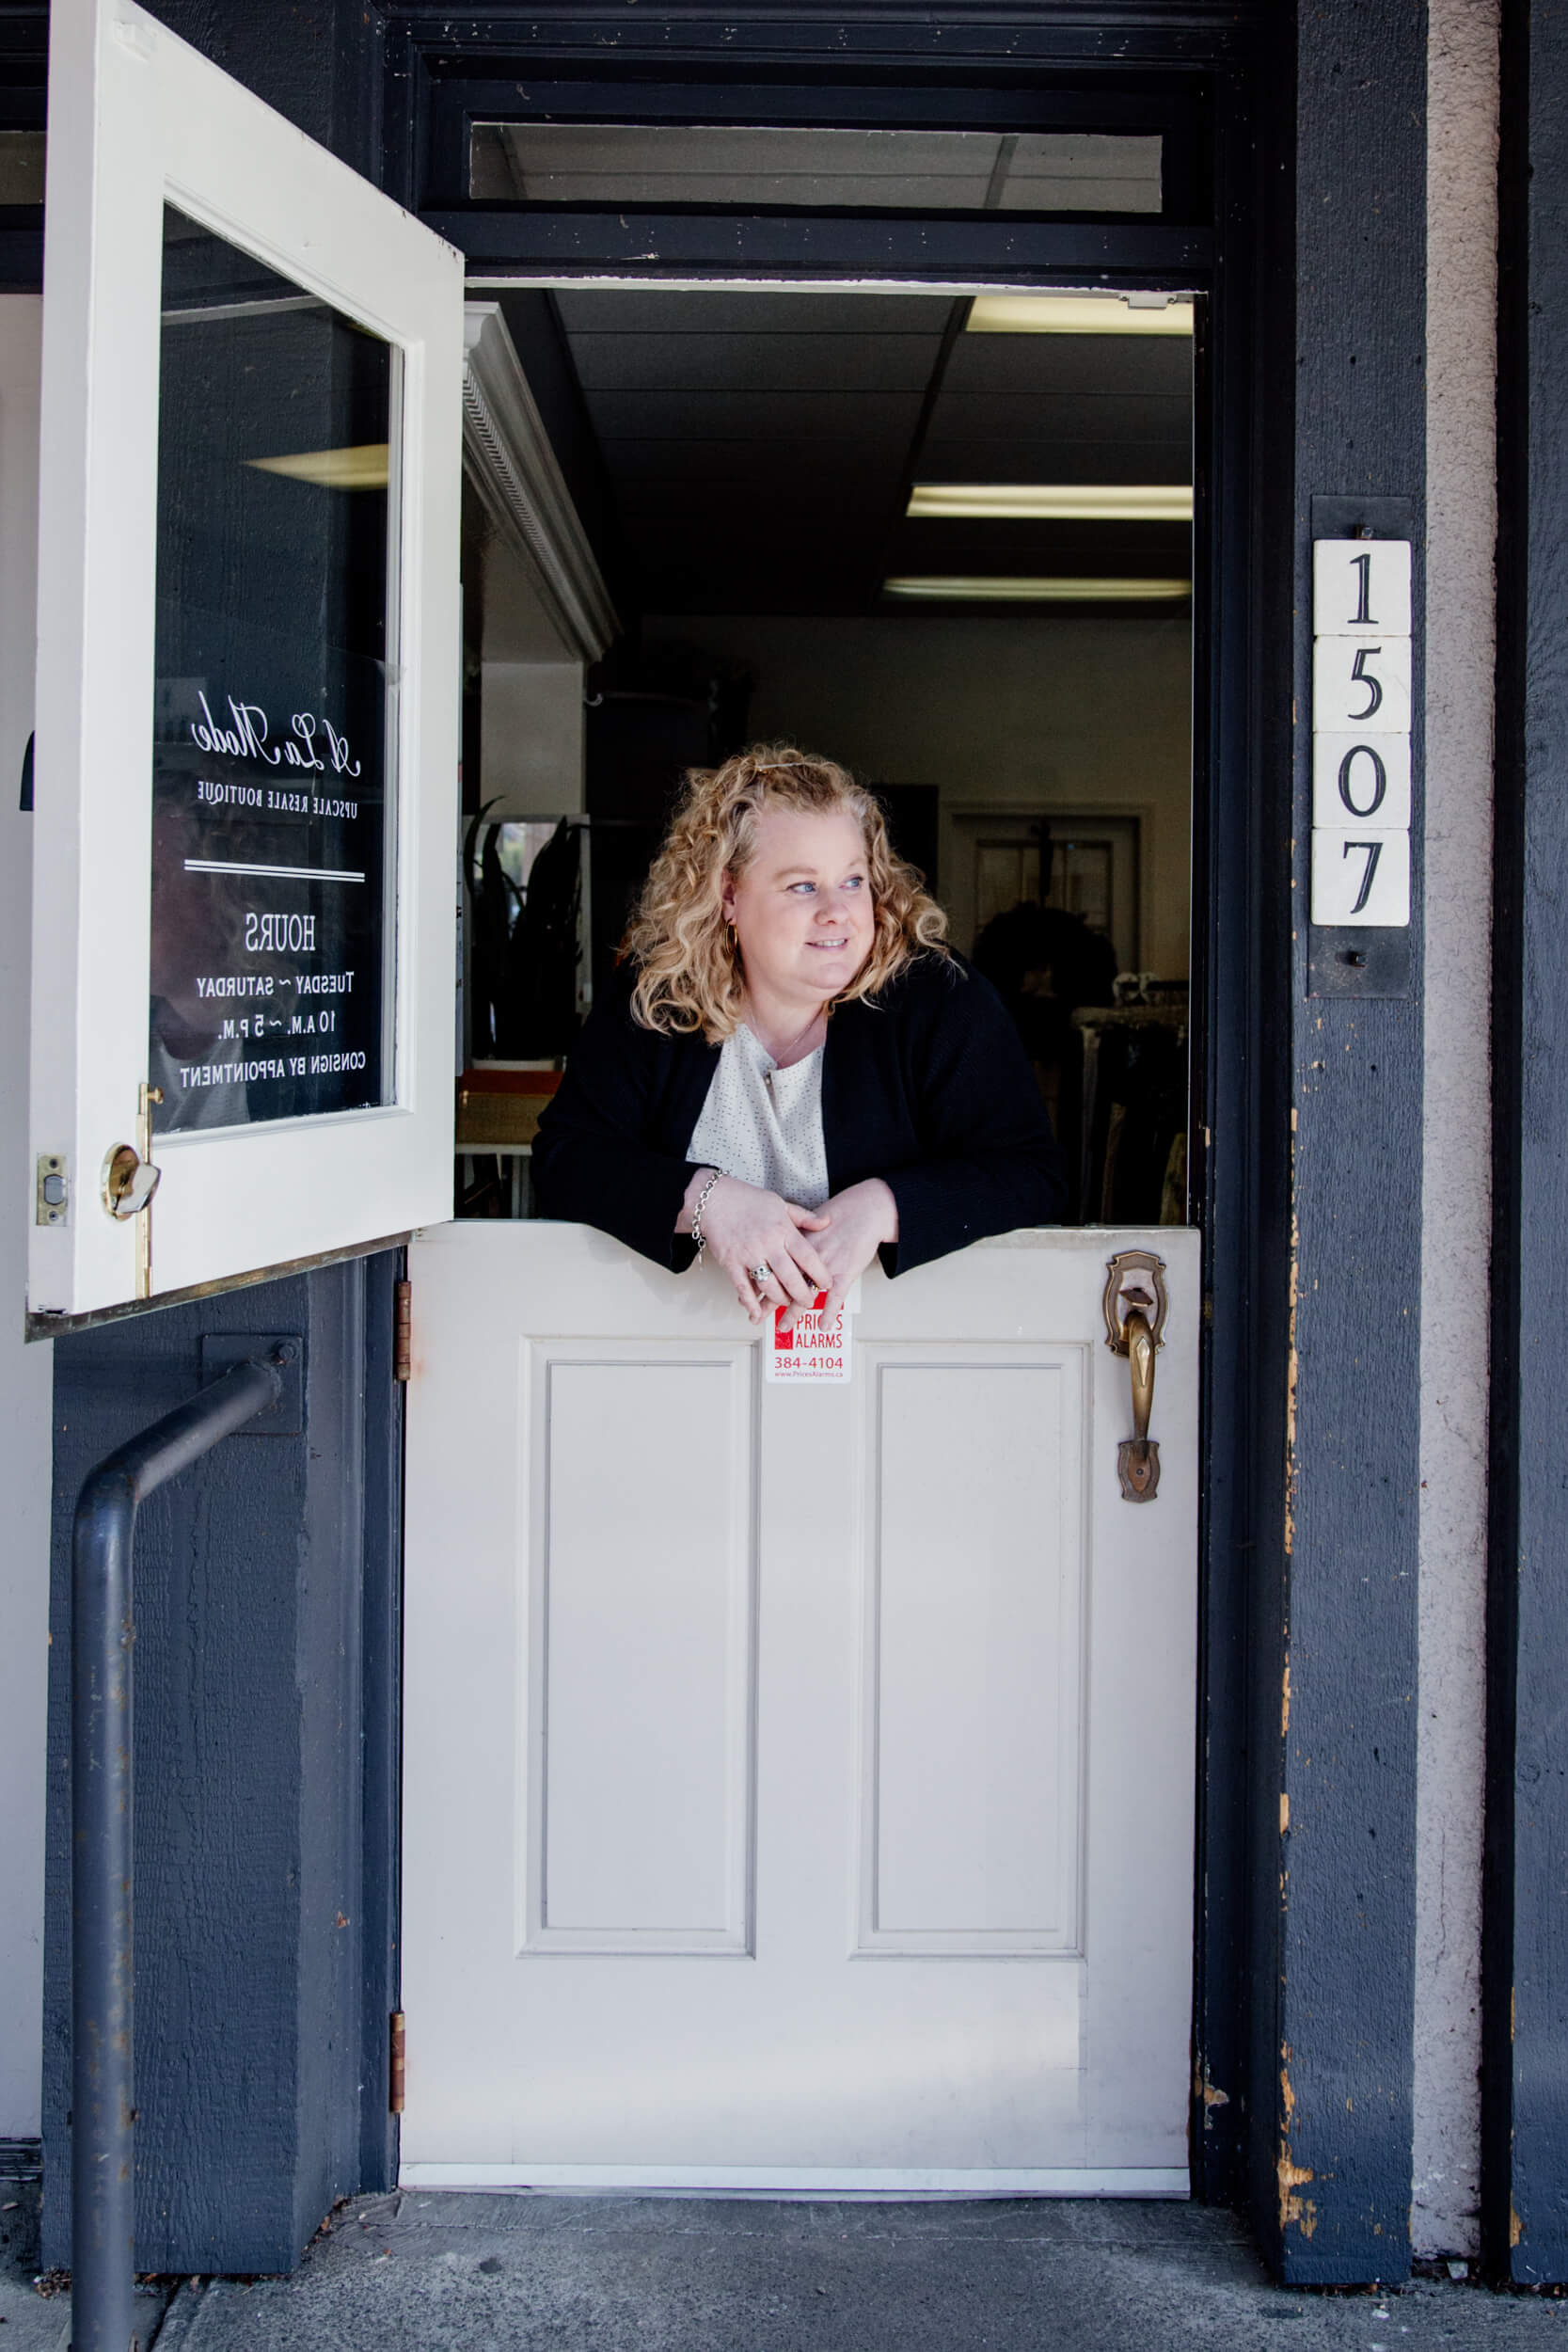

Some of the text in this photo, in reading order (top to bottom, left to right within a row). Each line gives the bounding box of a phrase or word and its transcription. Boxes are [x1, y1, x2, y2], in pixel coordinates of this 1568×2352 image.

[1338, 553, 1386, 914] 1507
[796, 1333, 843, 1349] ALARMS
[774, 1357, 844, 1369] 384-4104
